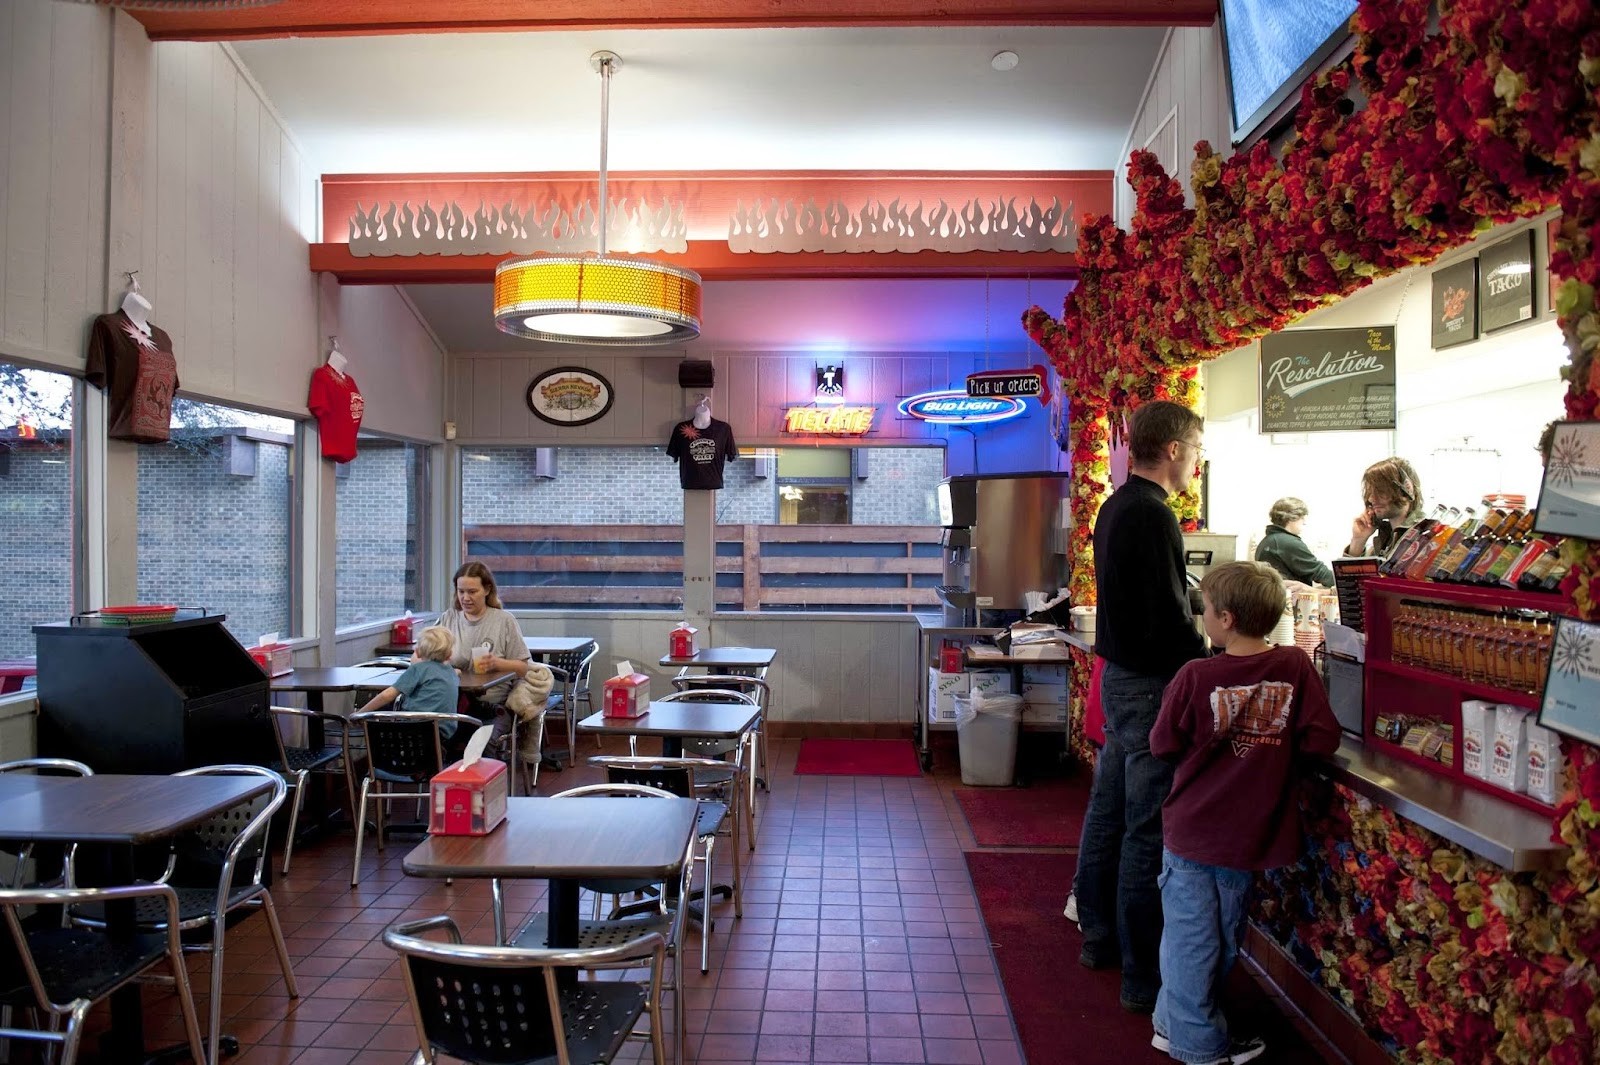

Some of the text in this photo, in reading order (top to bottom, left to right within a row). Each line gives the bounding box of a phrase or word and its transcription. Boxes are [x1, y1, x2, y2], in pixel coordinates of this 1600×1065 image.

[1488, 273, 1522, 296] TACO
[1367, 329, 1382, 337] Taco
[1370, 343, 1391, 351] Month
[1295, 356, 1310, 365] The
[1266, 350, 1385, 392] Resolution
[970, 380, 990, 395] Pick
[1008, 377, 1039, 392] orders
[923, 400, 1002, 412] BUD LIGHT
[787, 408, 875, 433] TECATE
